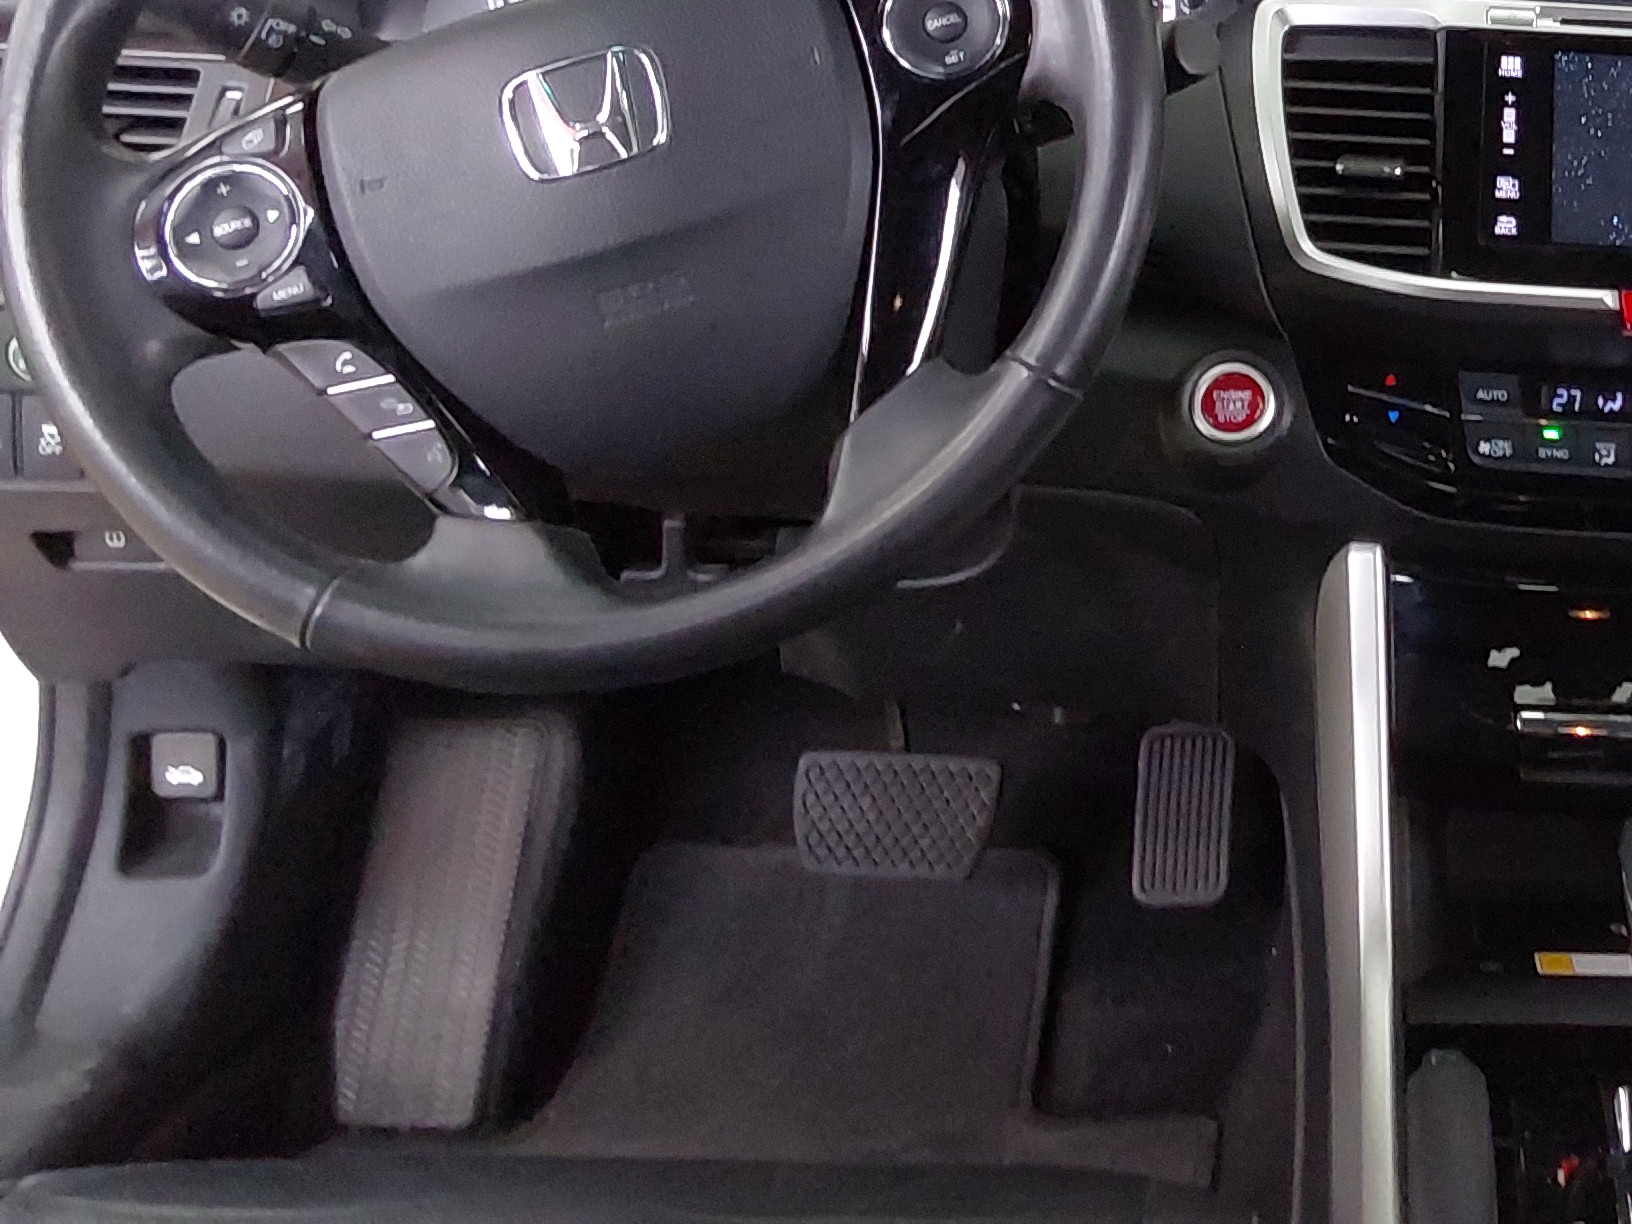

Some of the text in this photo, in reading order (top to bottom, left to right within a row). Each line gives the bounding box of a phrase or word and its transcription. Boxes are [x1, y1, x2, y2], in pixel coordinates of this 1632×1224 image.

[926, 13, 962, 31] CANCEL
[1494, 187, 1520, 200] MENU
[213, 217, 253, 237] SOURCE
[272, 282, 304, 302] MENU
[1476, 388, 1508, 402] AUTO
[1552, 387, 1581, 413] 27
[1538, 447, 1570, 460] SYNC
